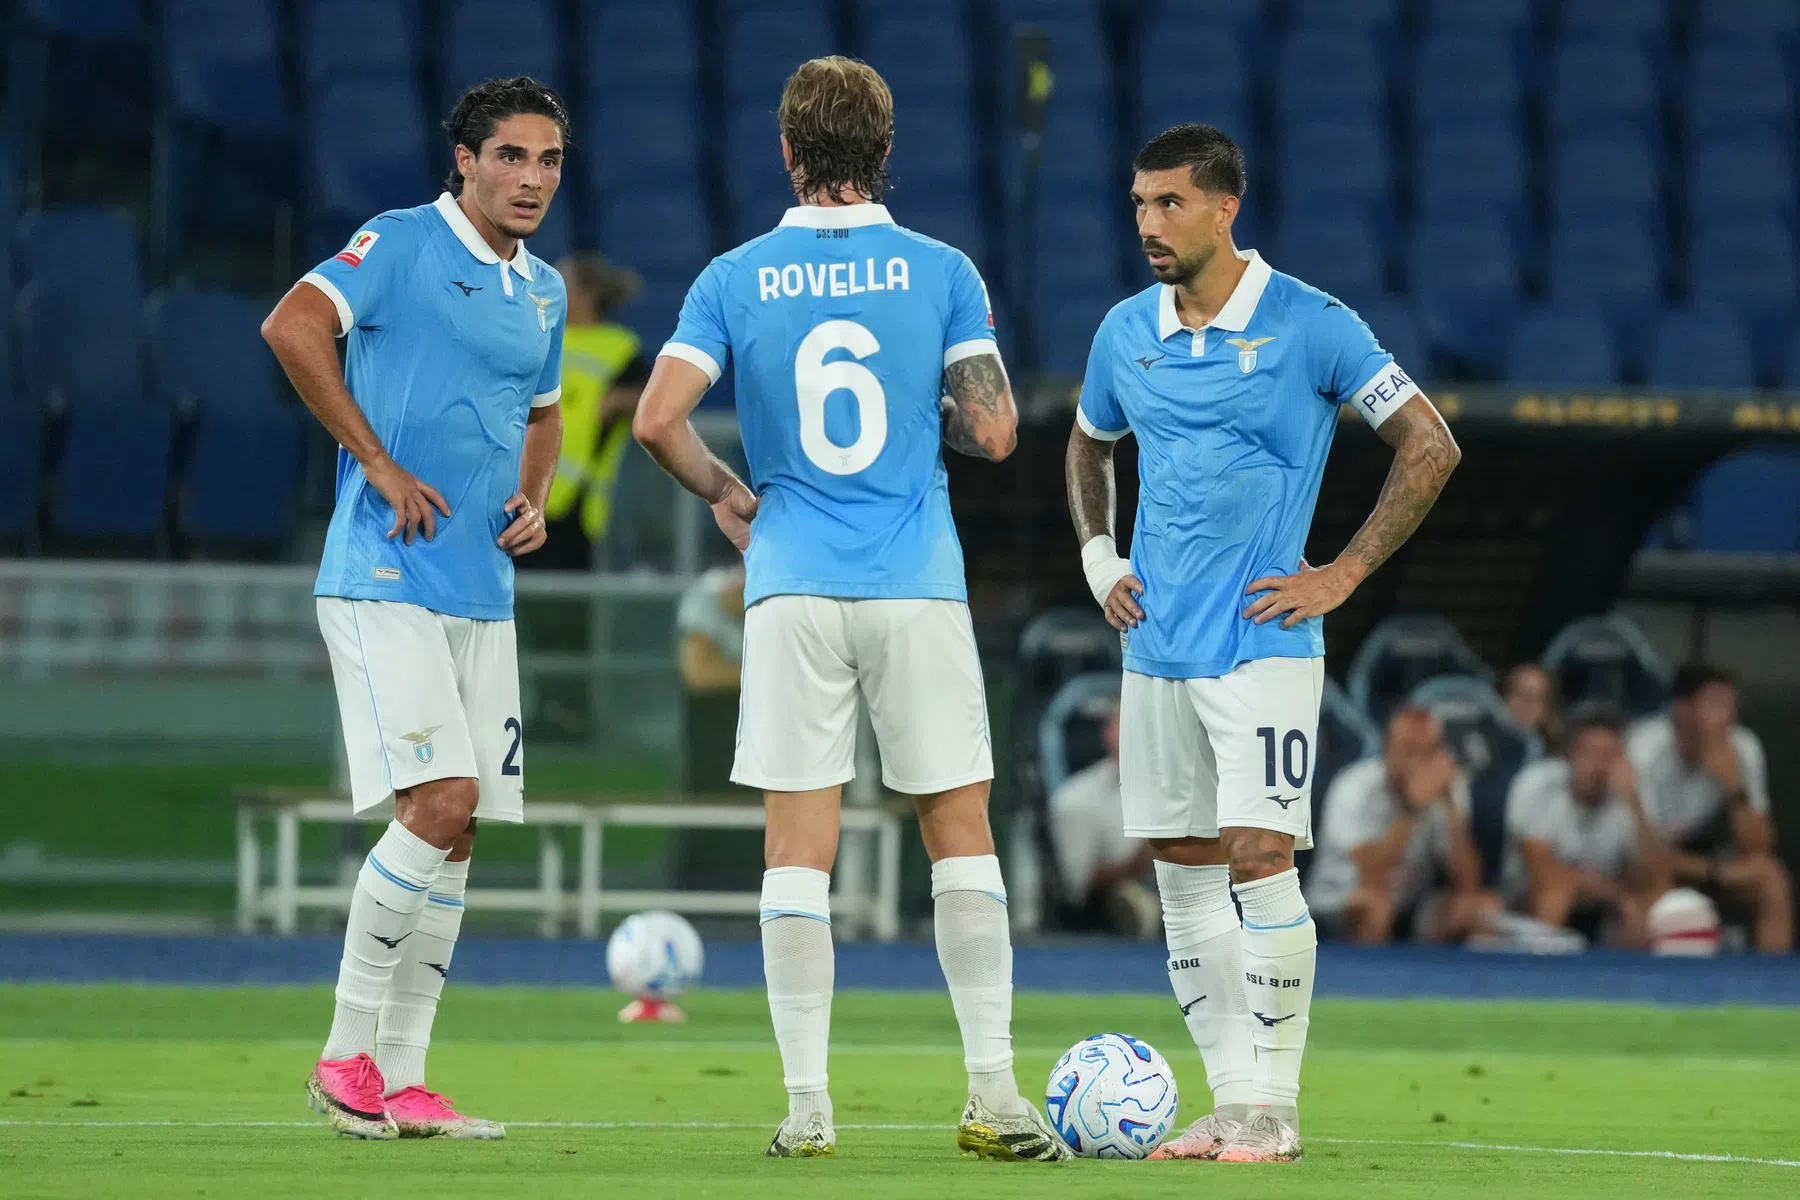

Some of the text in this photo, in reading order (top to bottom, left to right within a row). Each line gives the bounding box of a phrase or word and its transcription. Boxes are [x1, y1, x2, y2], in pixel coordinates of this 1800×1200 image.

[758, 256, 910, 302] ROVELLA
[794, 319, 888, 476] 6
[501, 717, 522, 776] 2
[1256, 727, 1308, 789] 10
[1171, 957, 1201, 971] 900
[1245, 972, 1266, 986] SSL
